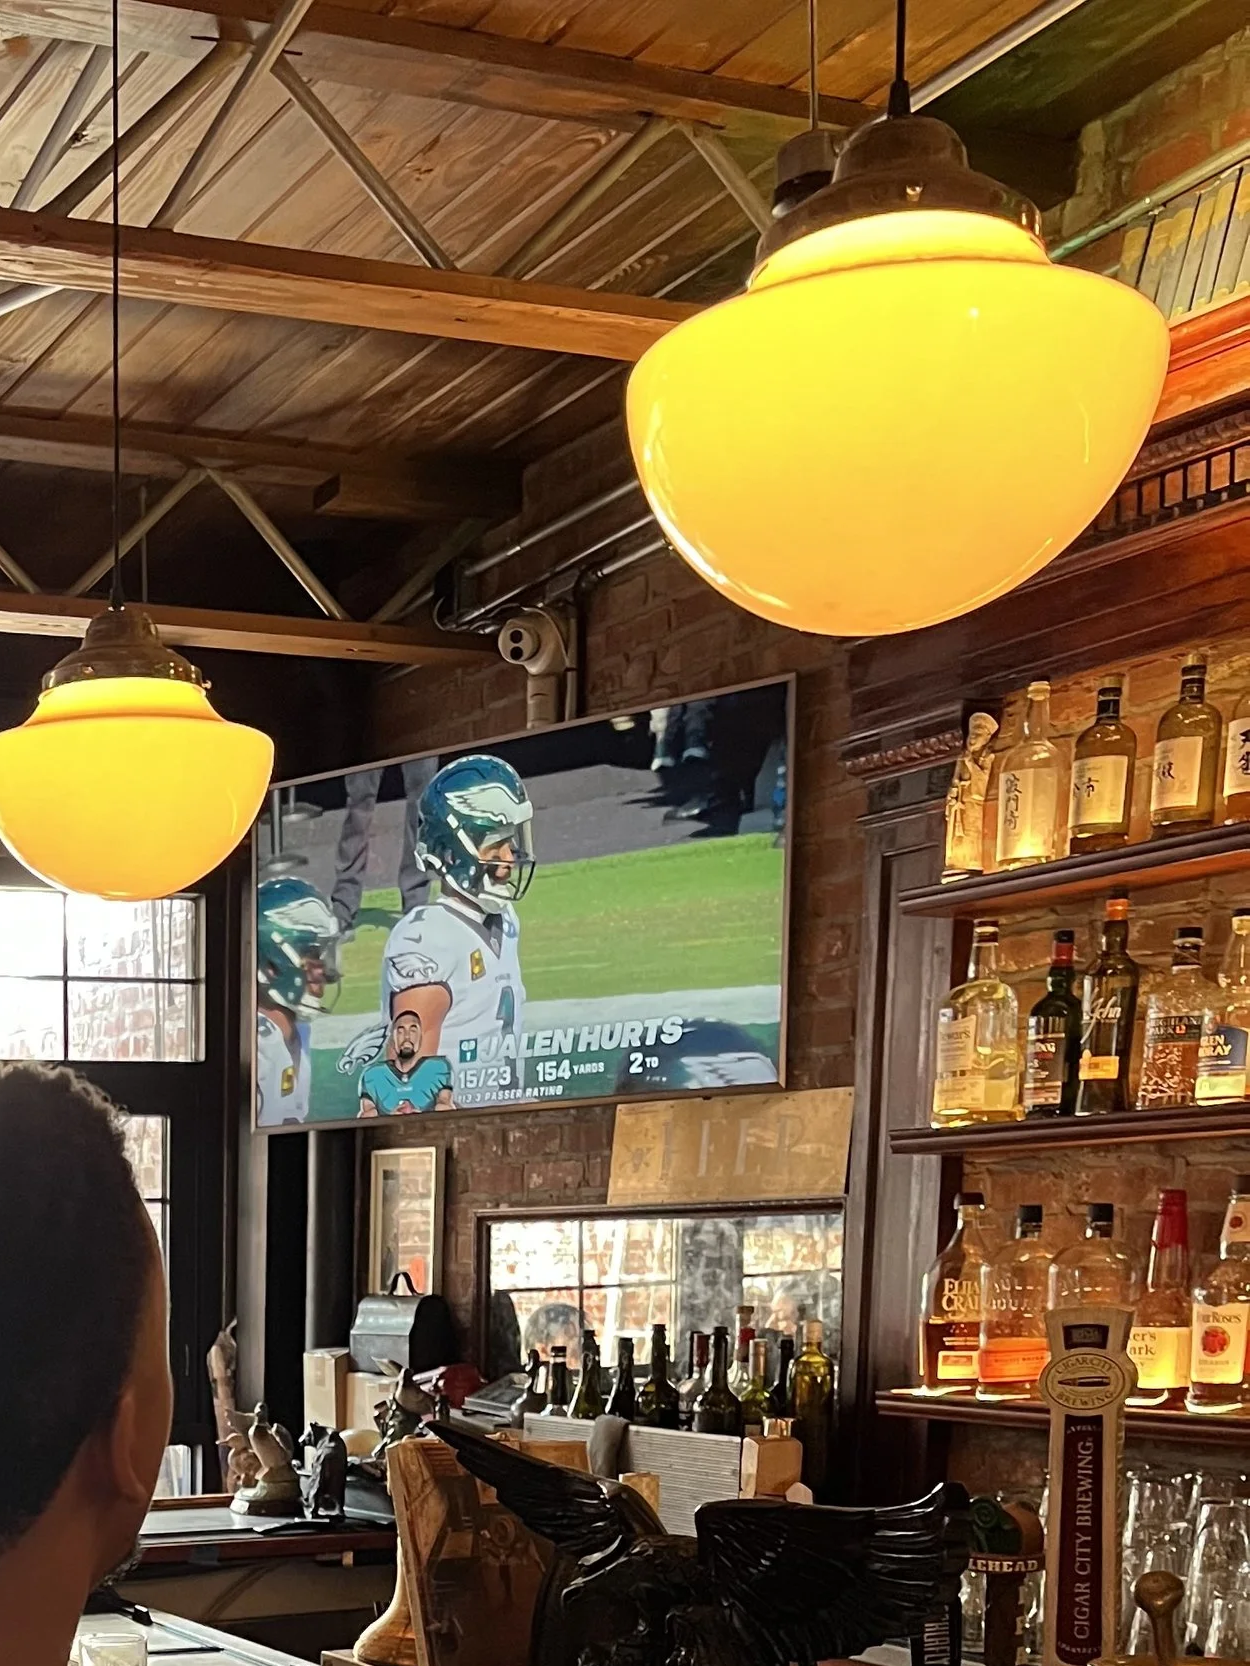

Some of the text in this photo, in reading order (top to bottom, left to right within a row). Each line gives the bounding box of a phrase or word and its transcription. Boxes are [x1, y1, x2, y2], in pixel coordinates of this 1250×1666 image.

[1150, 1015, 1201, 1027] HIGHLAN
[480, 1015, 685, 1063] JALEN HURTS
[459, 1066, 511, 1089] 15/23
[536, 1059, 571, 1082] 154
[572, 1062, 605, 1075] YARDS
[629, 1052, 644, 1074] 2
[484, 1088, 523, 1101] PASSER
[525, 1085, 563, 1097] RATING
[943, 1278, 980, 1295] ELIJA
[941, 1295, 979, 1312] CRAI
[1129, 1343, 1156, 1356] ark
[1055, 1357, 1090, 1375] CIGAR
[1056, 1390, 1116, 1406] BREWING
[1076, 1439, 1094, 1526] BREWING
[1074, 1531, 1092, 1576] CITY
[968, 1558, 1039, 1572] LEHEAD
[1074, 1583, 1091, 1640] CIGAR
